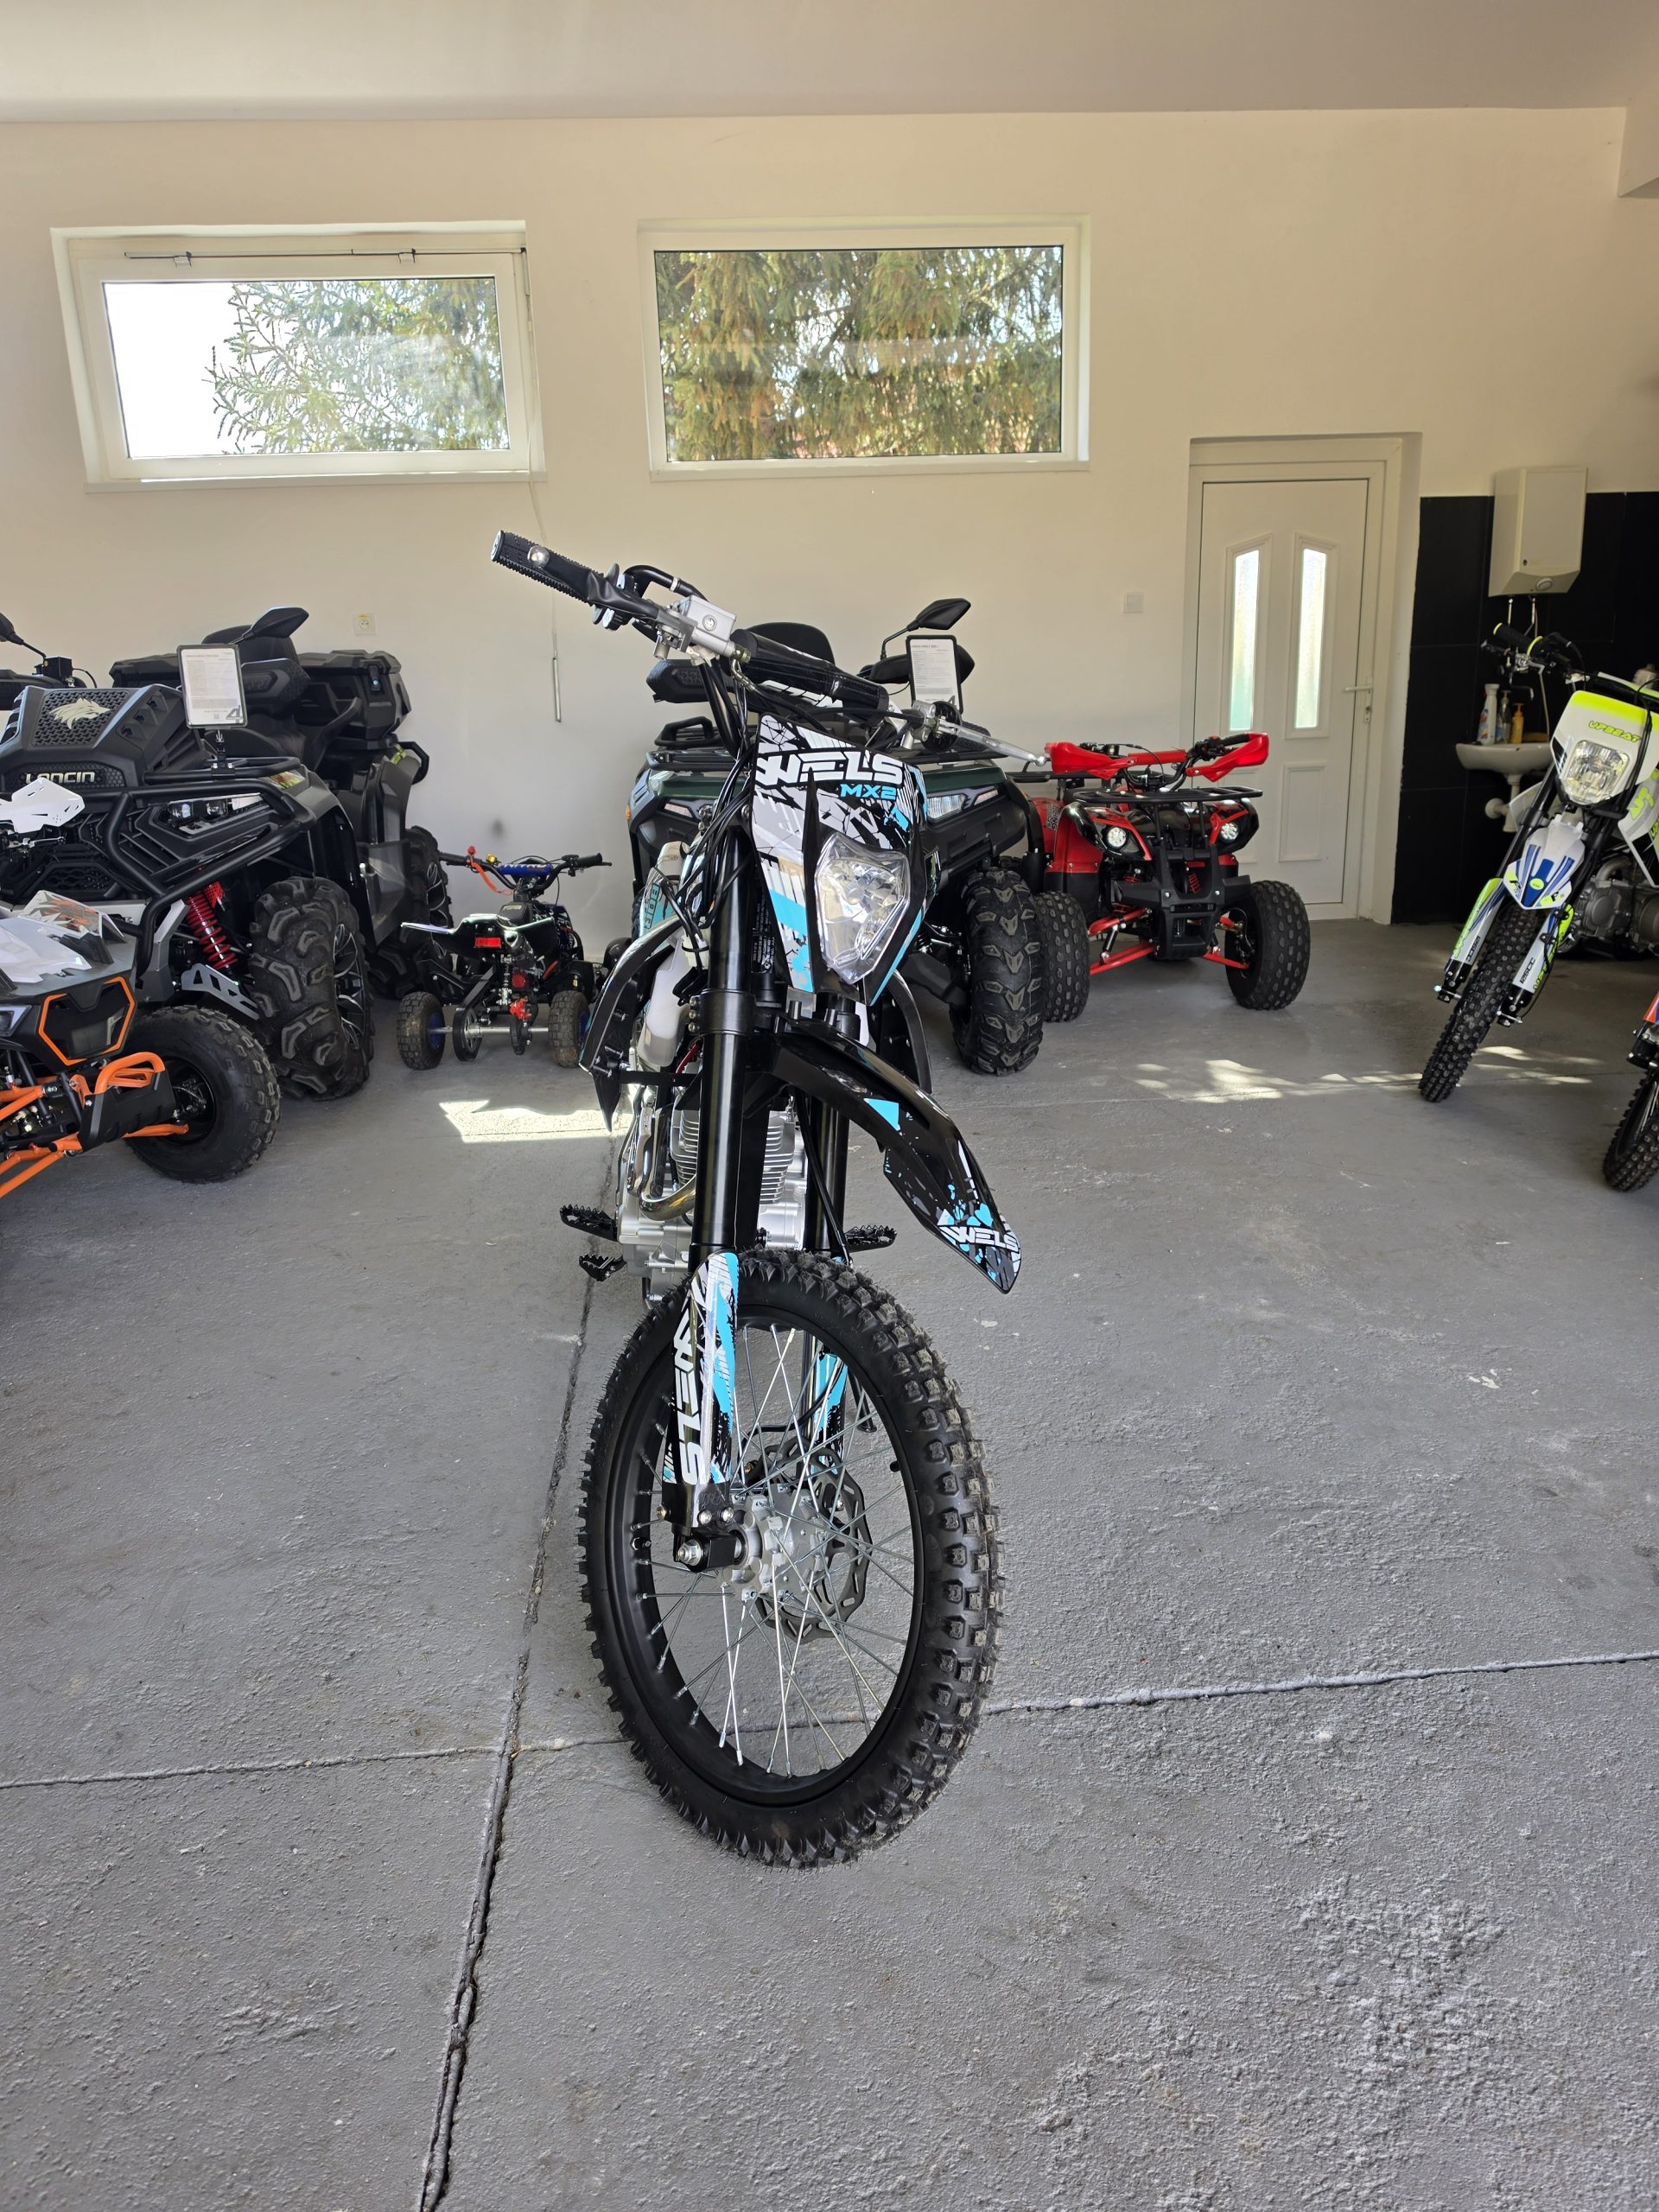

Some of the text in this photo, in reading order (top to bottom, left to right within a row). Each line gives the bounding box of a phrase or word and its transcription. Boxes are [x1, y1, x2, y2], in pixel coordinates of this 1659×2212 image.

[1588, 720, 1643, 742] UPBEAT
[755, 751, 903, 785] WELS
[840, 784, 897, 800] MX2
[1519, 957, 1536, 984] 125CC
[939, 1226, 1020, 1253] WELS
